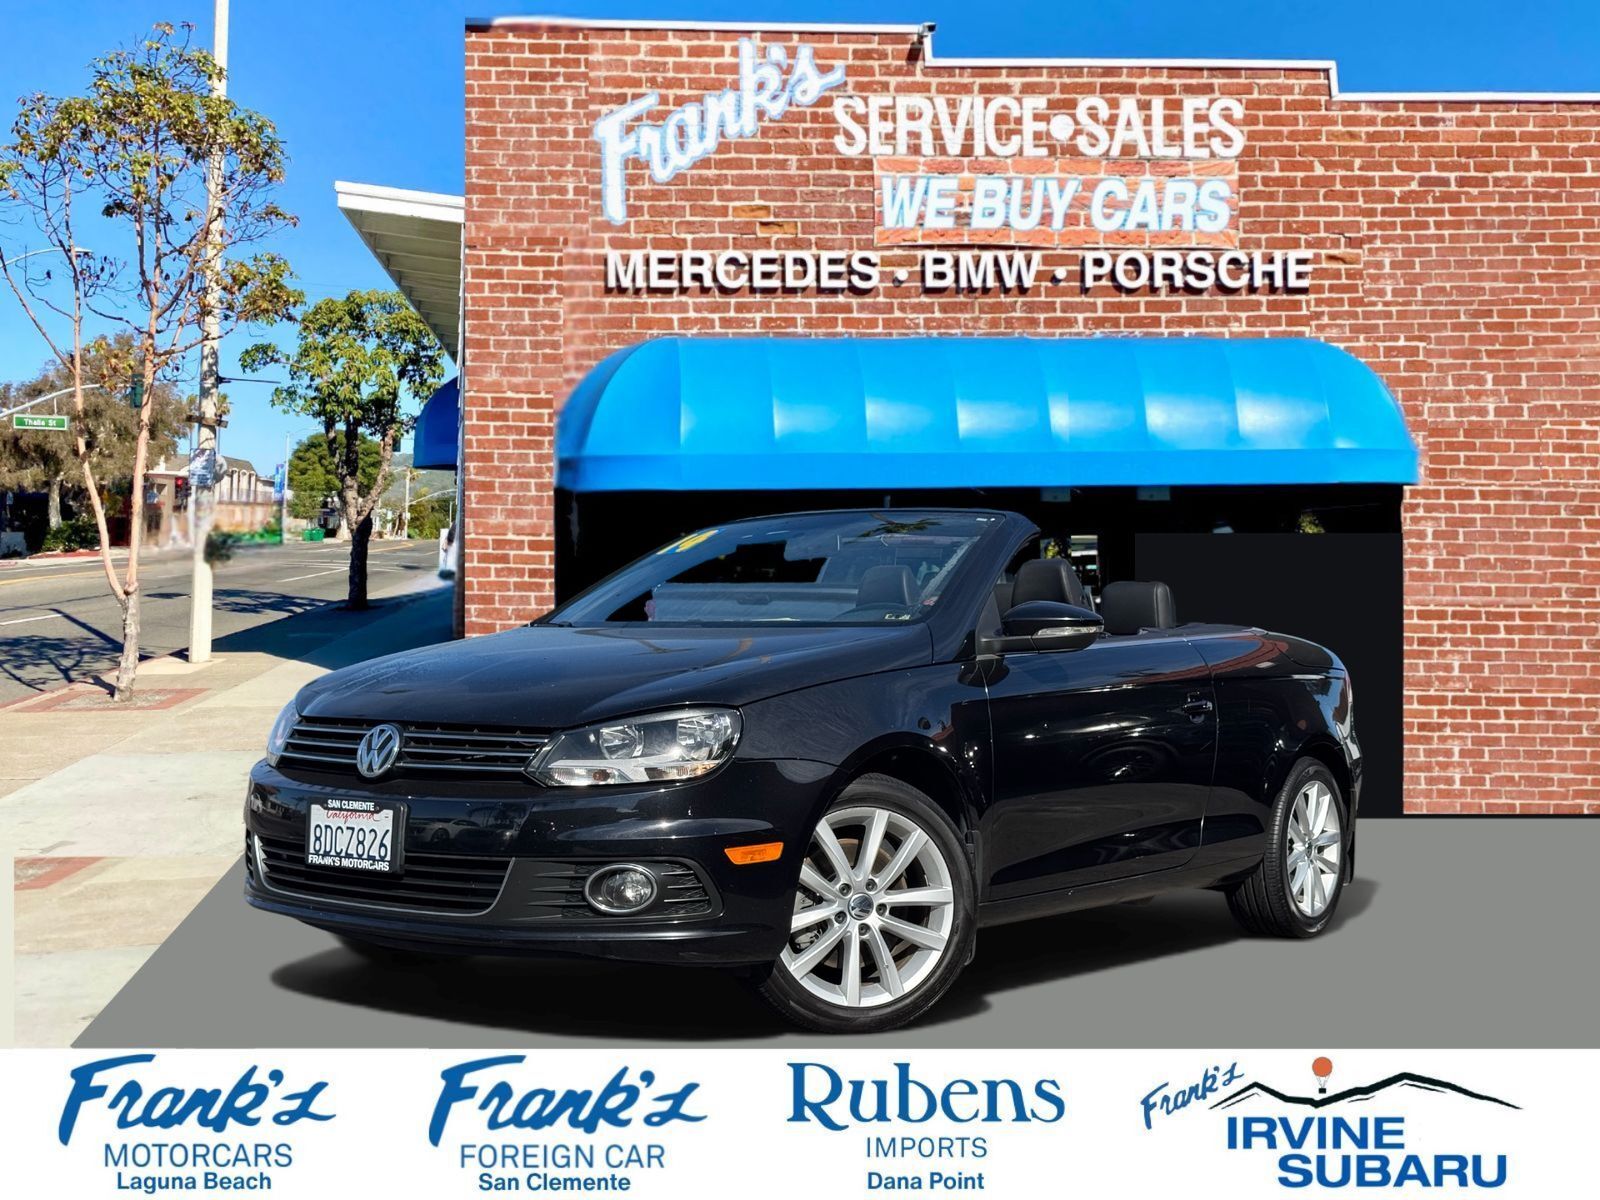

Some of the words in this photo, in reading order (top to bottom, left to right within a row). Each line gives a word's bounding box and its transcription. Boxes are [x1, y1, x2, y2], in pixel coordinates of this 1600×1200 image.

[594, 38, 846, 224] Frank's
[834, 96, 1049, 156] SERVICE
[1075, 97, 1245, 159] SALES
[881, 174, 962, 230] WE
[970, 176, 1081, 232] BUY
[1090, 177, 1232, 233] CARS
[606, 250, 881, 292] MERCEDES
[922, 252, 1040, 290] BMW
[1081, 249, 1314, 293] PORSCHE
[48, 419, 57, 427] St
[327, 799, 340, 808] SAN
[341, 801, 375, 811] CLEMENTE
[313, 824, 390, 860] 8DCZ826
[308, 855, 341, 866] FRANK'S
[341, 858, 390, 871] MOTORCARS
